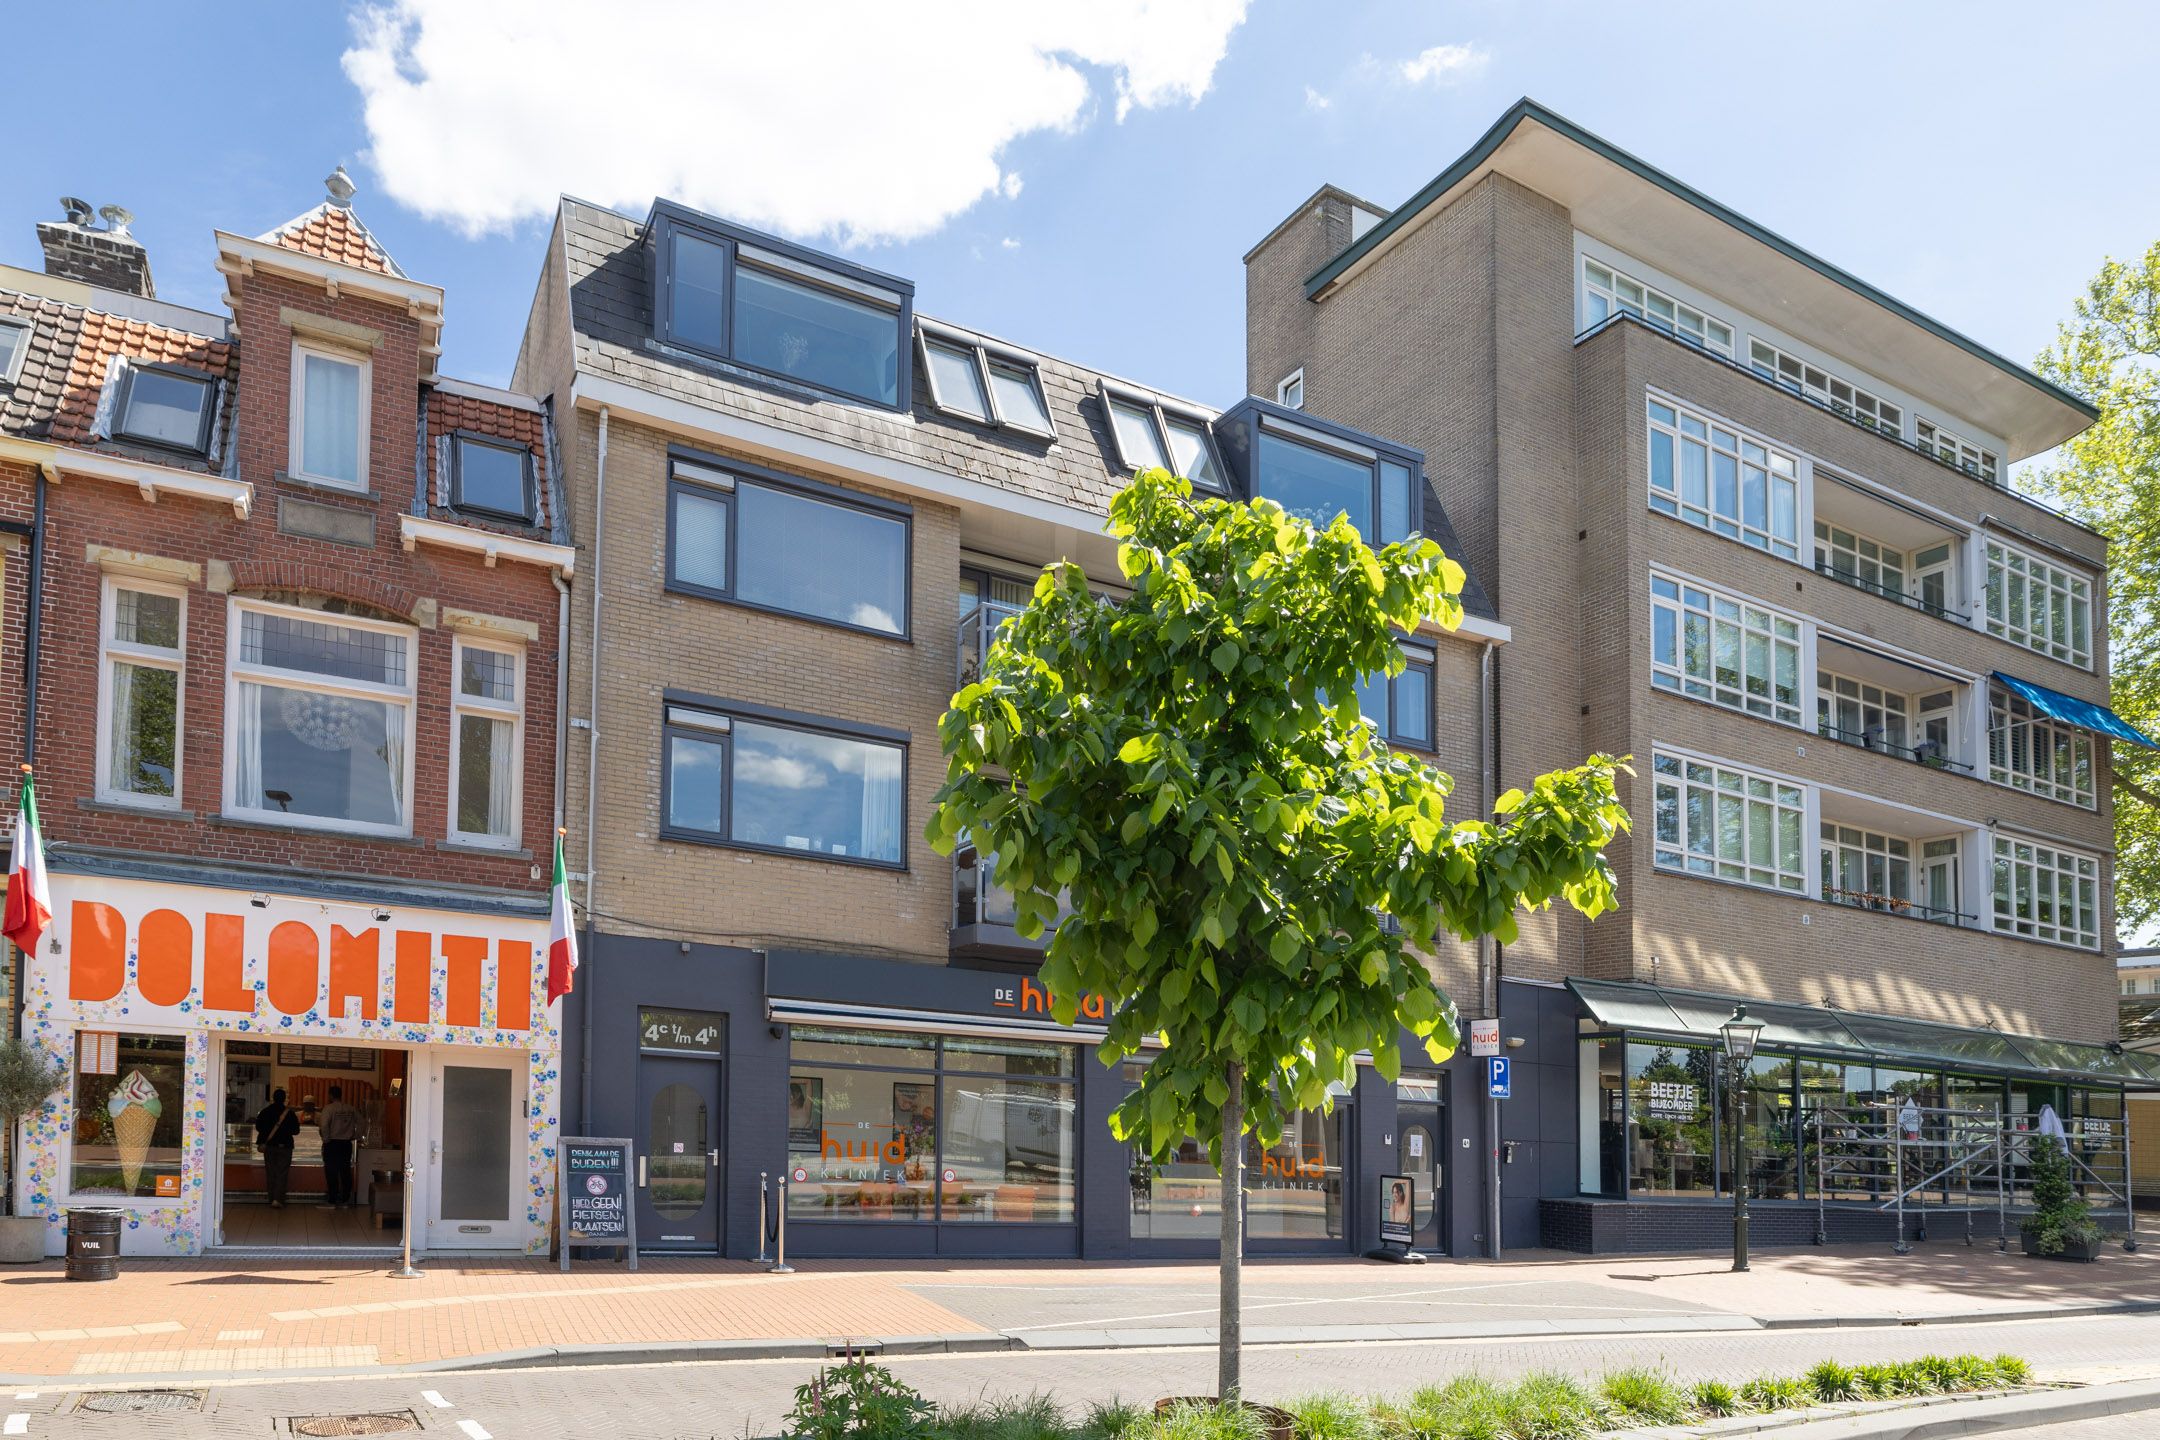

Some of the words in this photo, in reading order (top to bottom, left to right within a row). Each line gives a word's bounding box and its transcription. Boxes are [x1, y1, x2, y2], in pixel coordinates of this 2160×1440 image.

[69, 900, 532, 1031] DOLOMITI
[995, 988, 1013, 1001] DE
[1472, 1030, 1498, 1043] huid
[1493, 1060, 1505, 1080] P
[1650, 1081, 1694, 1101] BEETJE
[1650, 1098, 1693, 1112] BIJZONDER
[858, 1121, 870, 1129] DE
[571, 1149, 593, 1157] DENK
[593, 1150, 608, 1158] AAN
[609, 1150, 620, 1158] DE
[821, 1129, 906, 1165] huid
[571, 1158, 609, 1169] BUREN
[1262, 1149, 1326, 1178] huid
[821, 1168, 906, 1182] KLINIEK
[1262, 1181, 1324, 1192] KLINIEK
[572, 1197, 591, 1209] HIER
[572, 1210, 619, 1220] FIETSEN
[81, 1241, 100, 1249] VUIL
